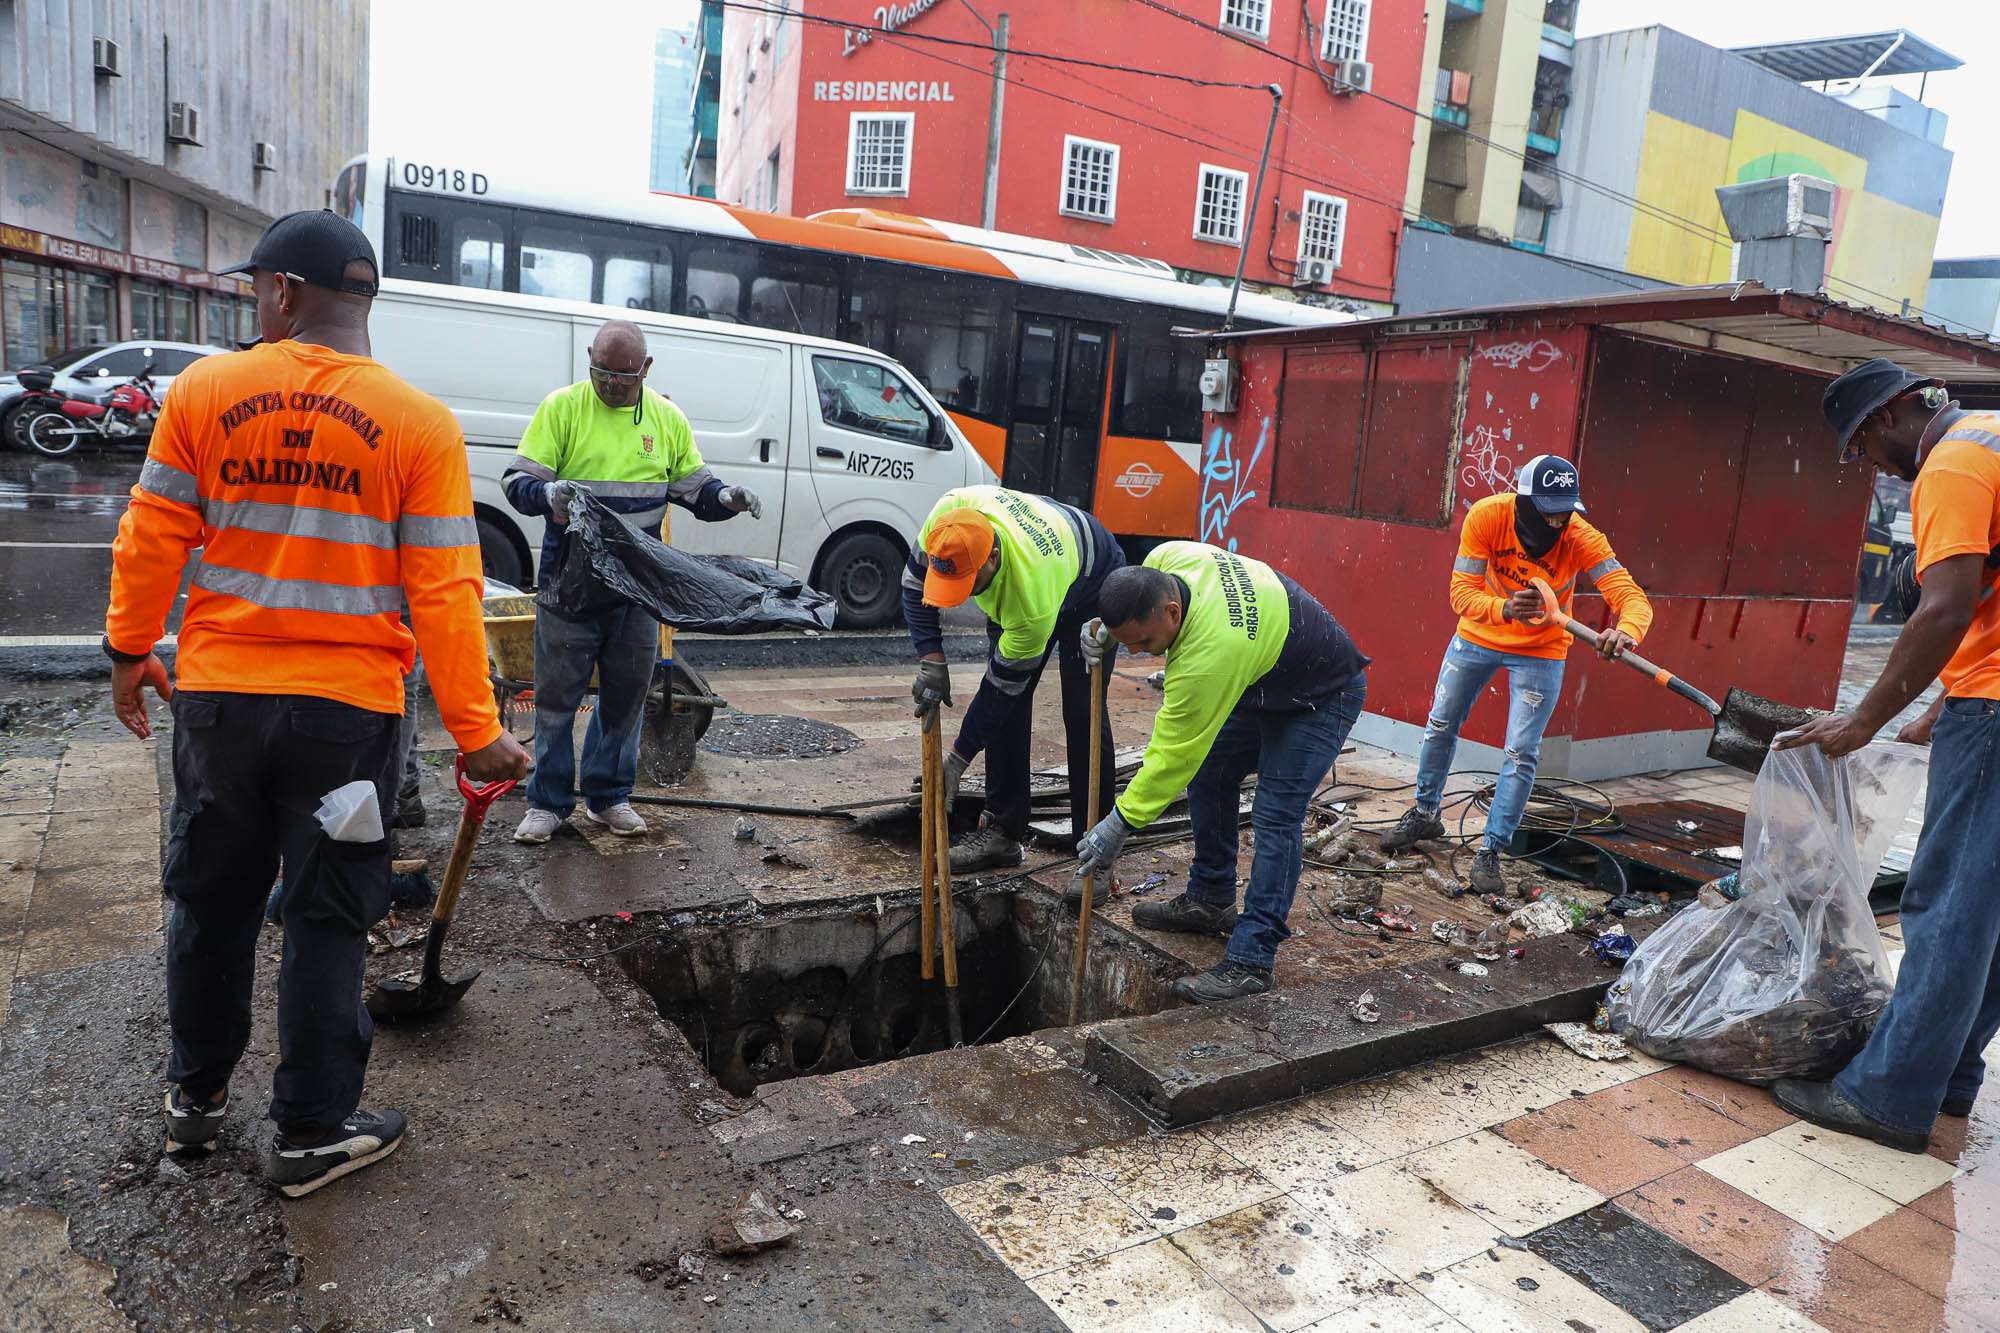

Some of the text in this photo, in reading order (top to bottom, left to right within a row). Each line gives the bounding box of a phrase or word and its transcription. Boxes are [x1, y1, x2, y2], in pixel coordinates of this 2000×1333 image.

[813, 80, 955, 102] RESIDENCIAL
[404, 163, 489, 195] 0918 D
[219, 390, 383, 450] JUNTA COMUNAL
[281, 428, 313, 449] DE
[220, 457, 362, 497] CALIDONIA
[846, 450, 915, 480] AR7265
[1245, 605, 1259, 641] OBRAS
